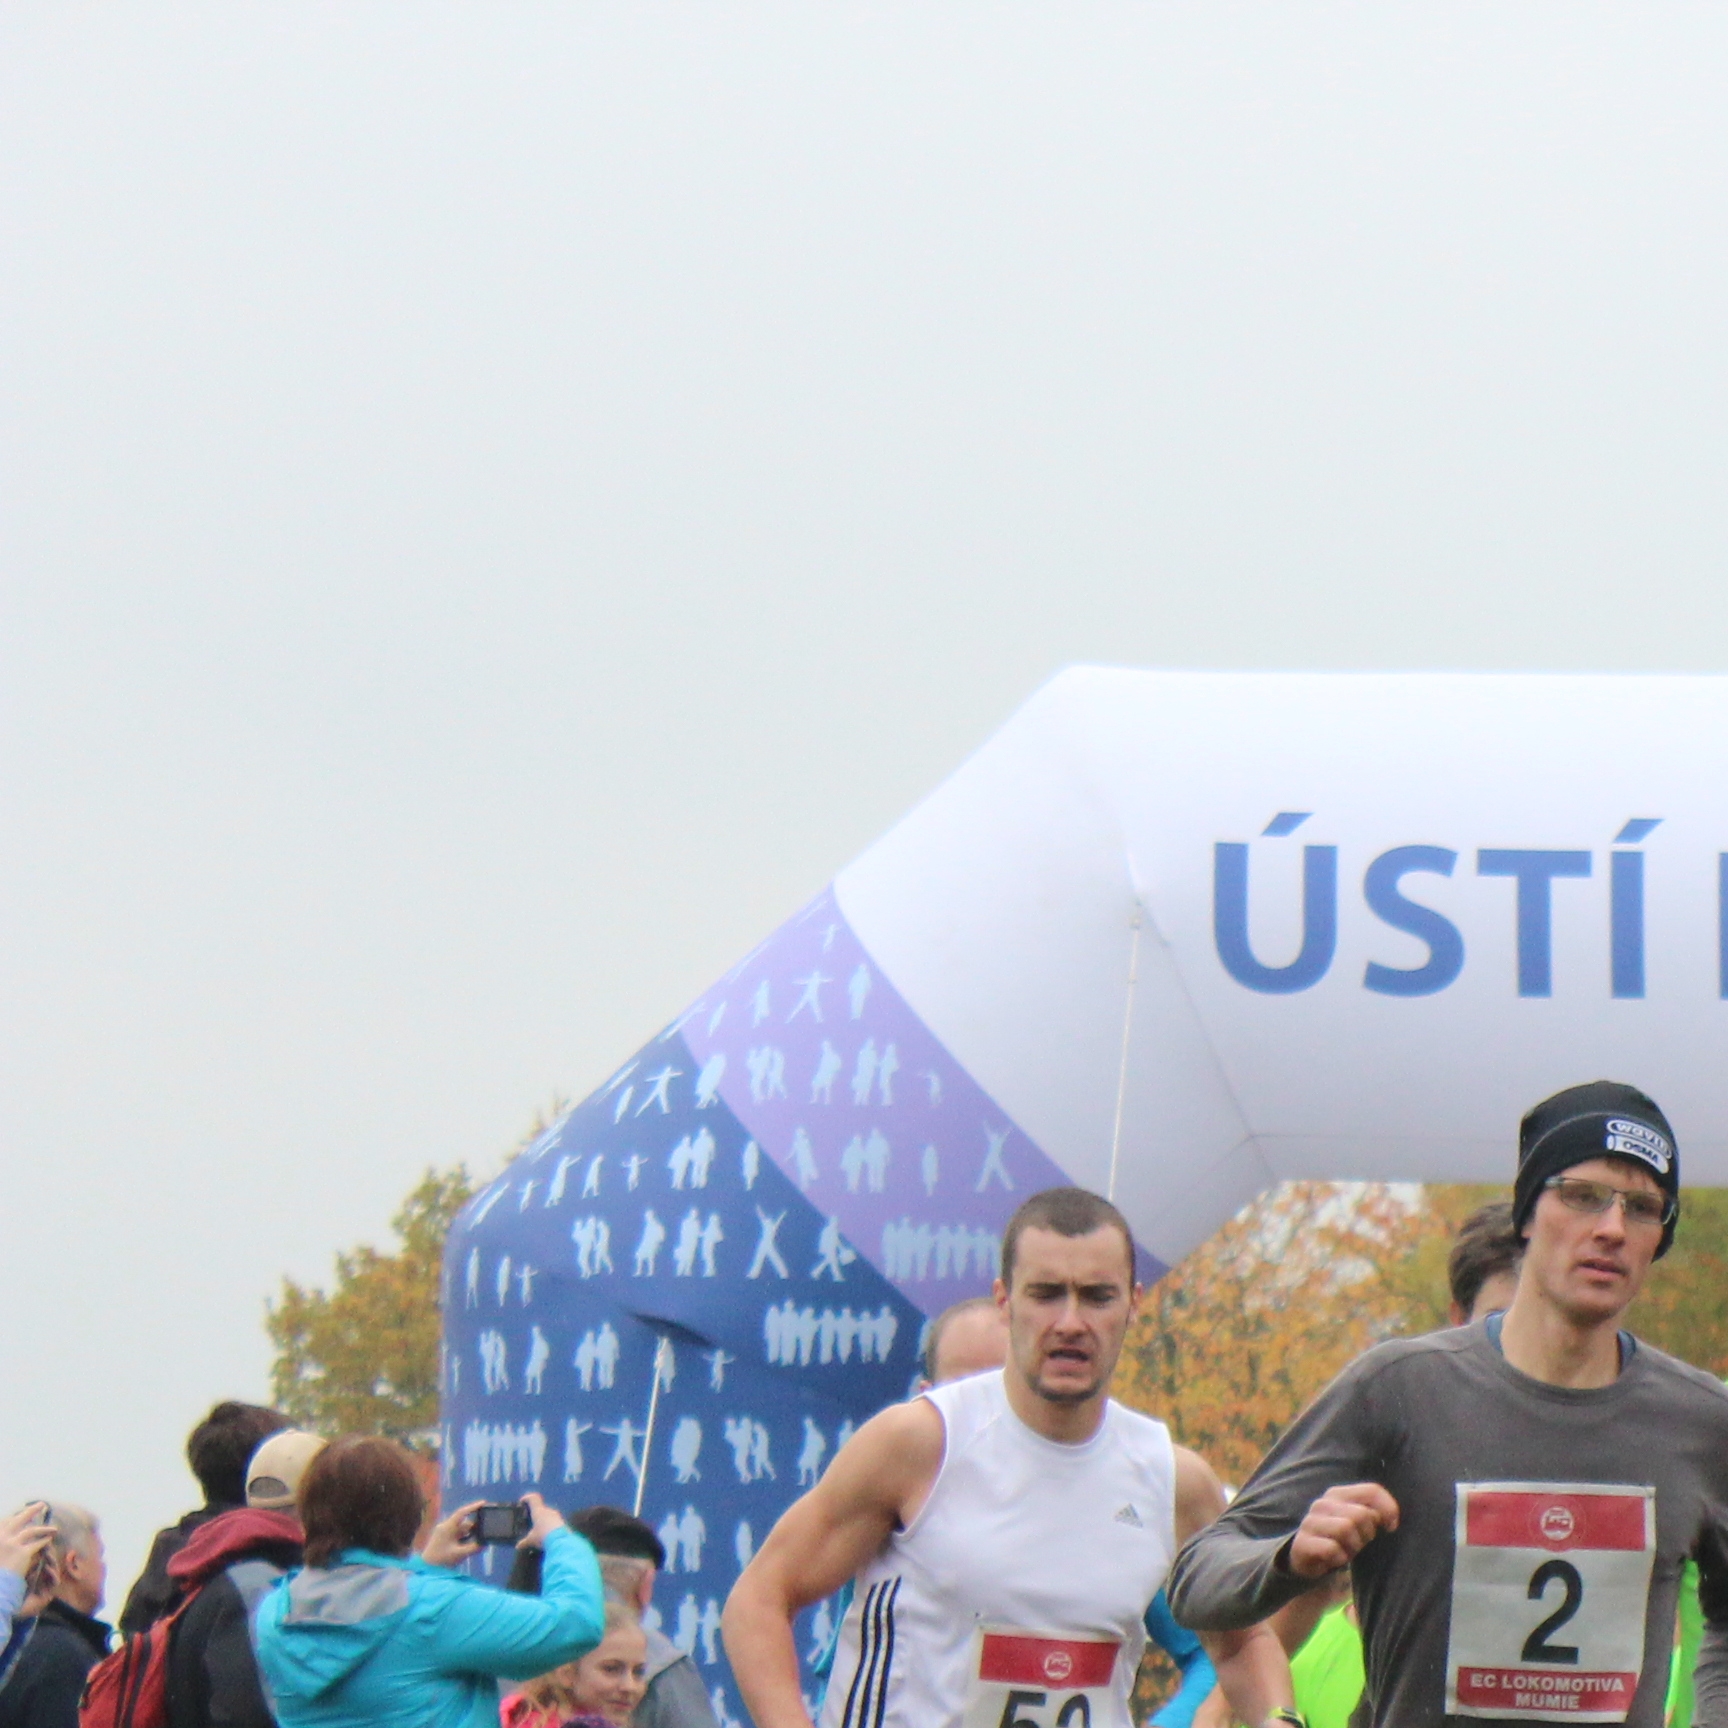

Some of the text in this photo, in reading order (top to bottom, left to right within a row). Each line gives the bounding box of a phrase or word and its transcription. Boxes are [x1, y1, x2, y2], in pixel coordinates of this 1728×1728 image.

[1213, 811, 1665, 999] ÚSTÍ
[1520, 1559, 1583, 1665] 2
[1469, 1673, 1625, 1693] EC LOKOMOTIVA
[1514, 1692, 1581, 1710] MUMIE
